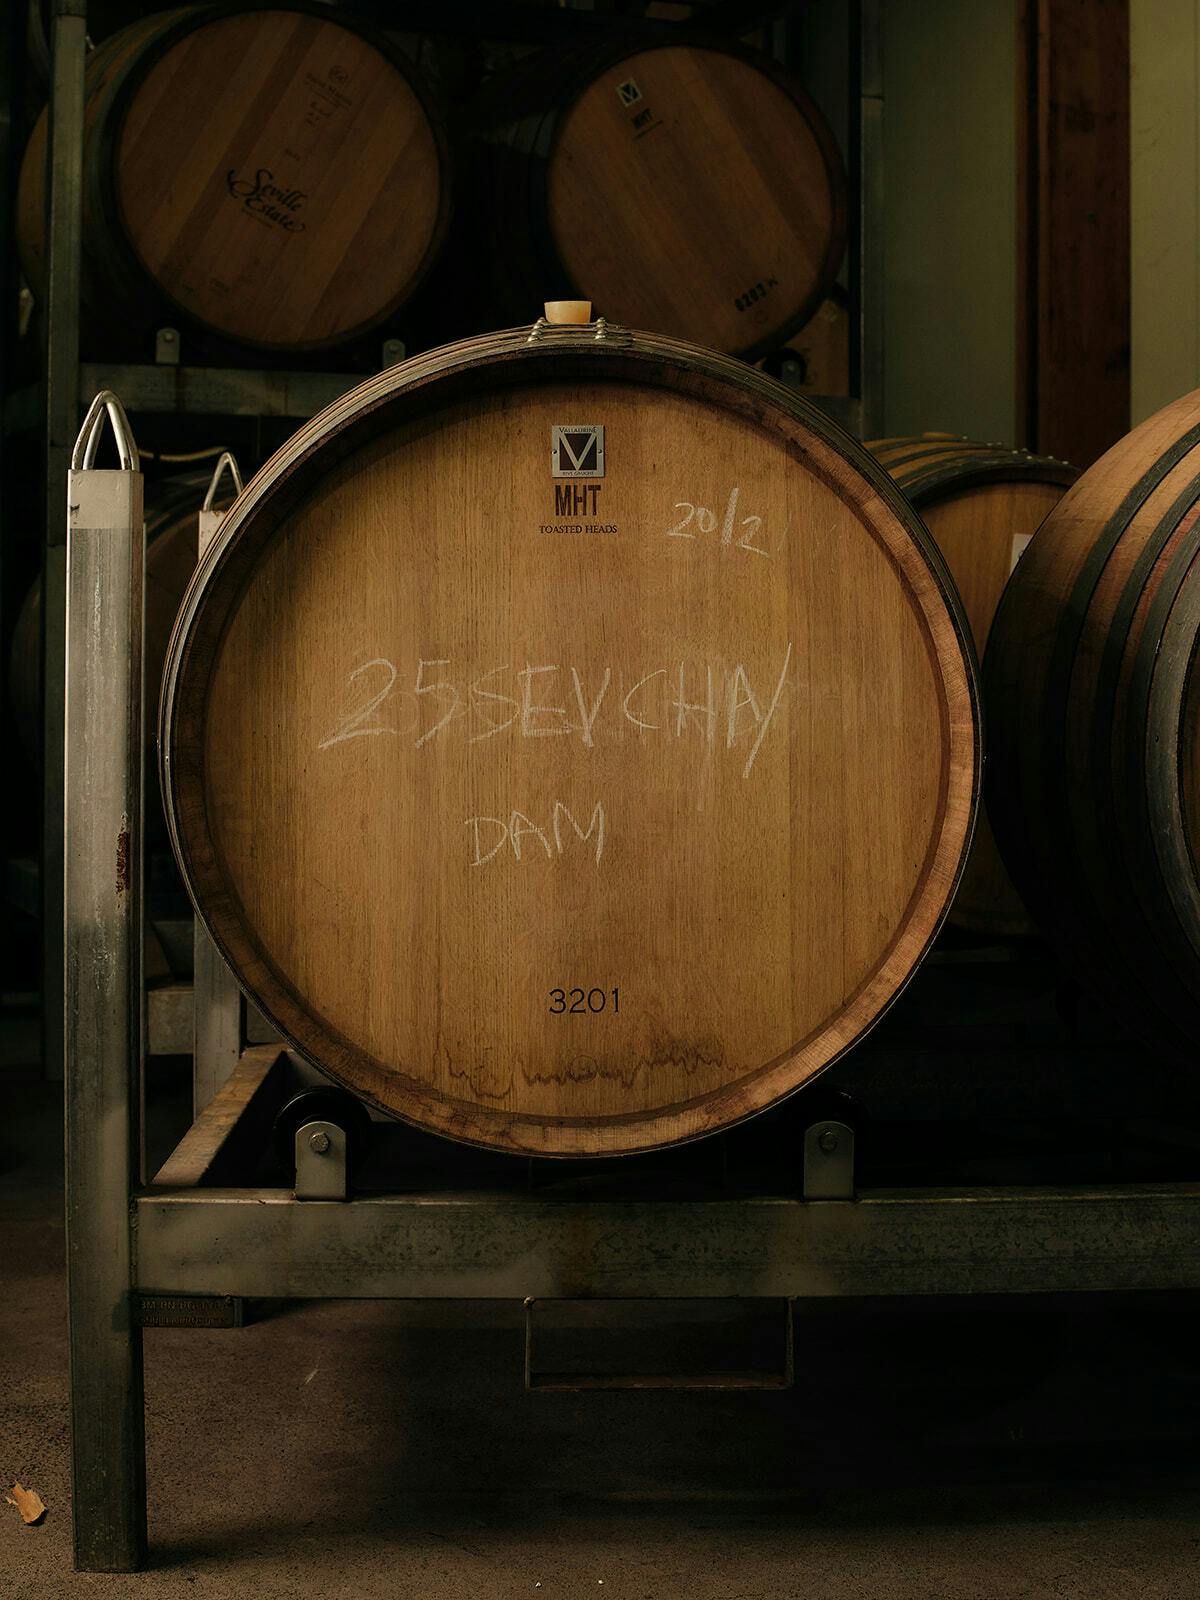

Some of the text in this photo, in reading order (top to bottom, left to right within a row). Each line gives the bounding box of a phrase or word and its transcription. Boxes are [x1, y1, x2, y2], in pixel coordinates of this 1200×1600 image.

[227, 168, 308, 211] Seville
[244, 196, 308, 232] Estate
[555, 484, 601, 516] MHT
[539, 525, 618, 534] TOASTED HEADS
[464, 800, 606, 867] DAM
[548, 987, 620, 1014] 3201
